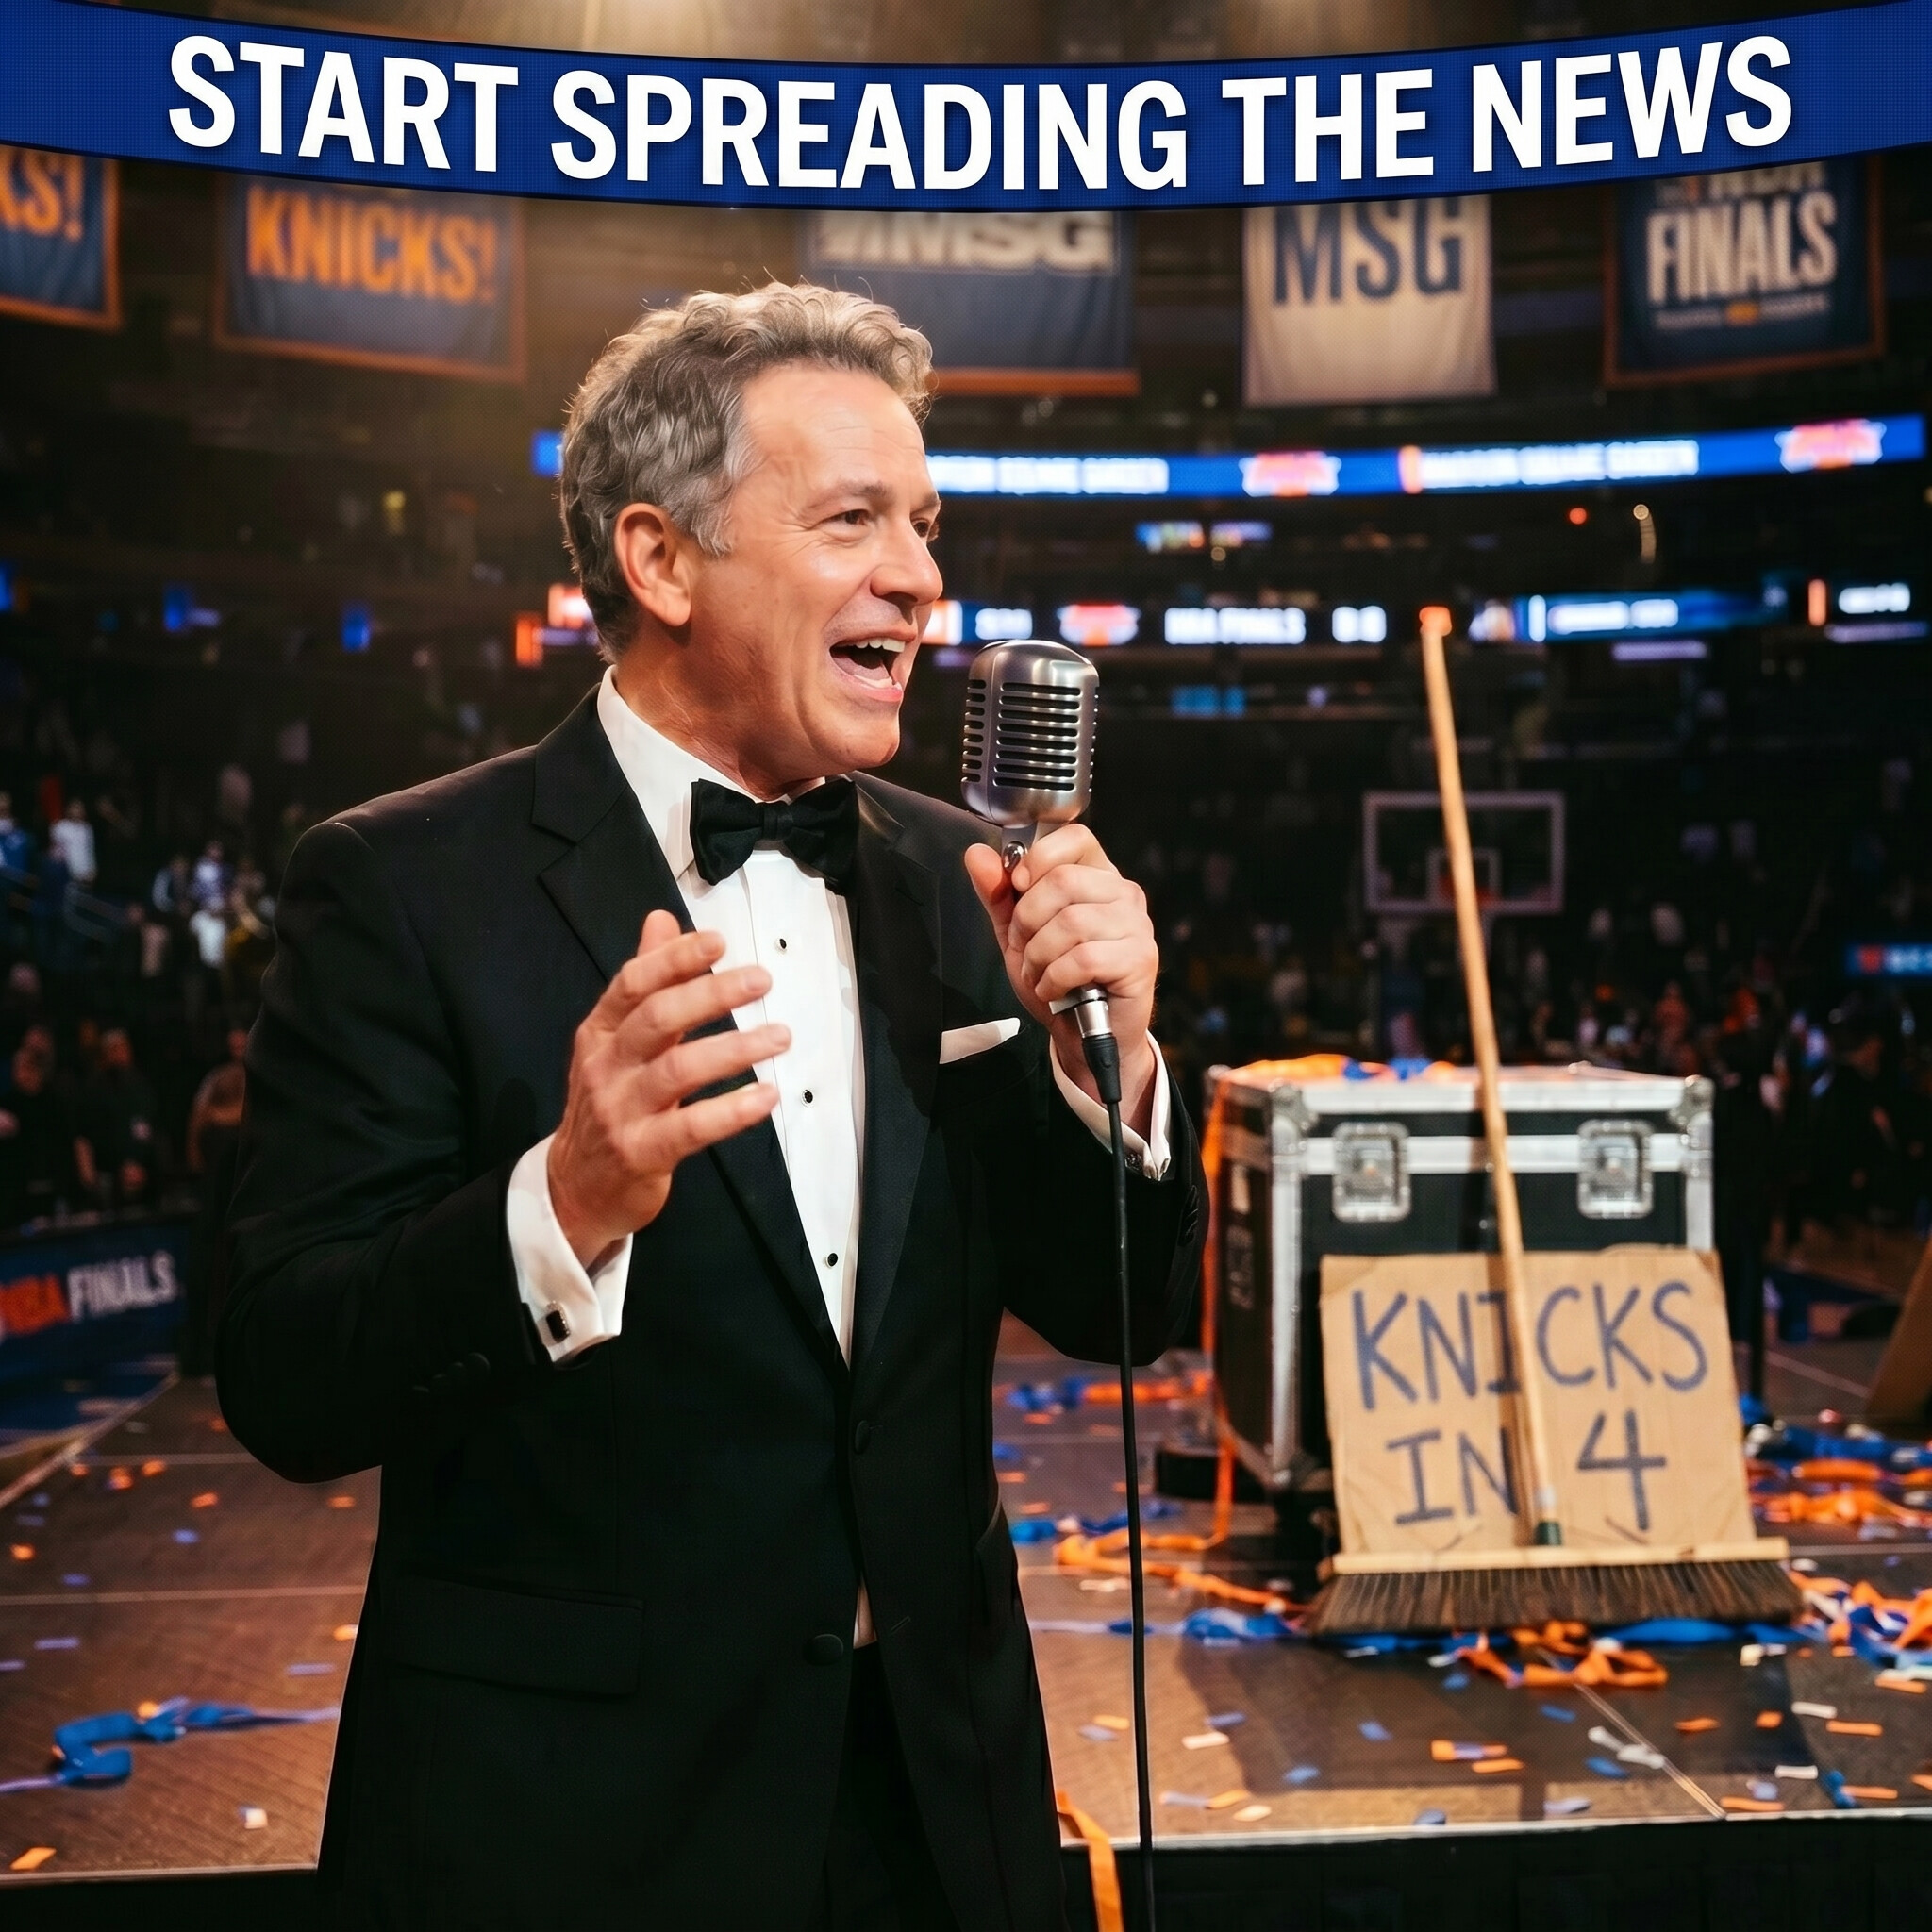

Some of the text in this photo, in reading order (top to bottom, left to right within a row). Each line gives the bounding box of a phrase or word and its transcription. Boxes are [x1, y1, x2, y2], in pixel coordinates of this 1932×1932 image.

[168, 35, 1792, 190] START SPREADING THE NEWS
[246, 185, 496, 304] KNICKS!
[1275, 200, 1461, 306] MSG
[1647, 191, 1837, 307] FINALS
[1352, 1280, 1709, 1411] KNICKS
[1386, 1408, 1668, 1531] IN 4
